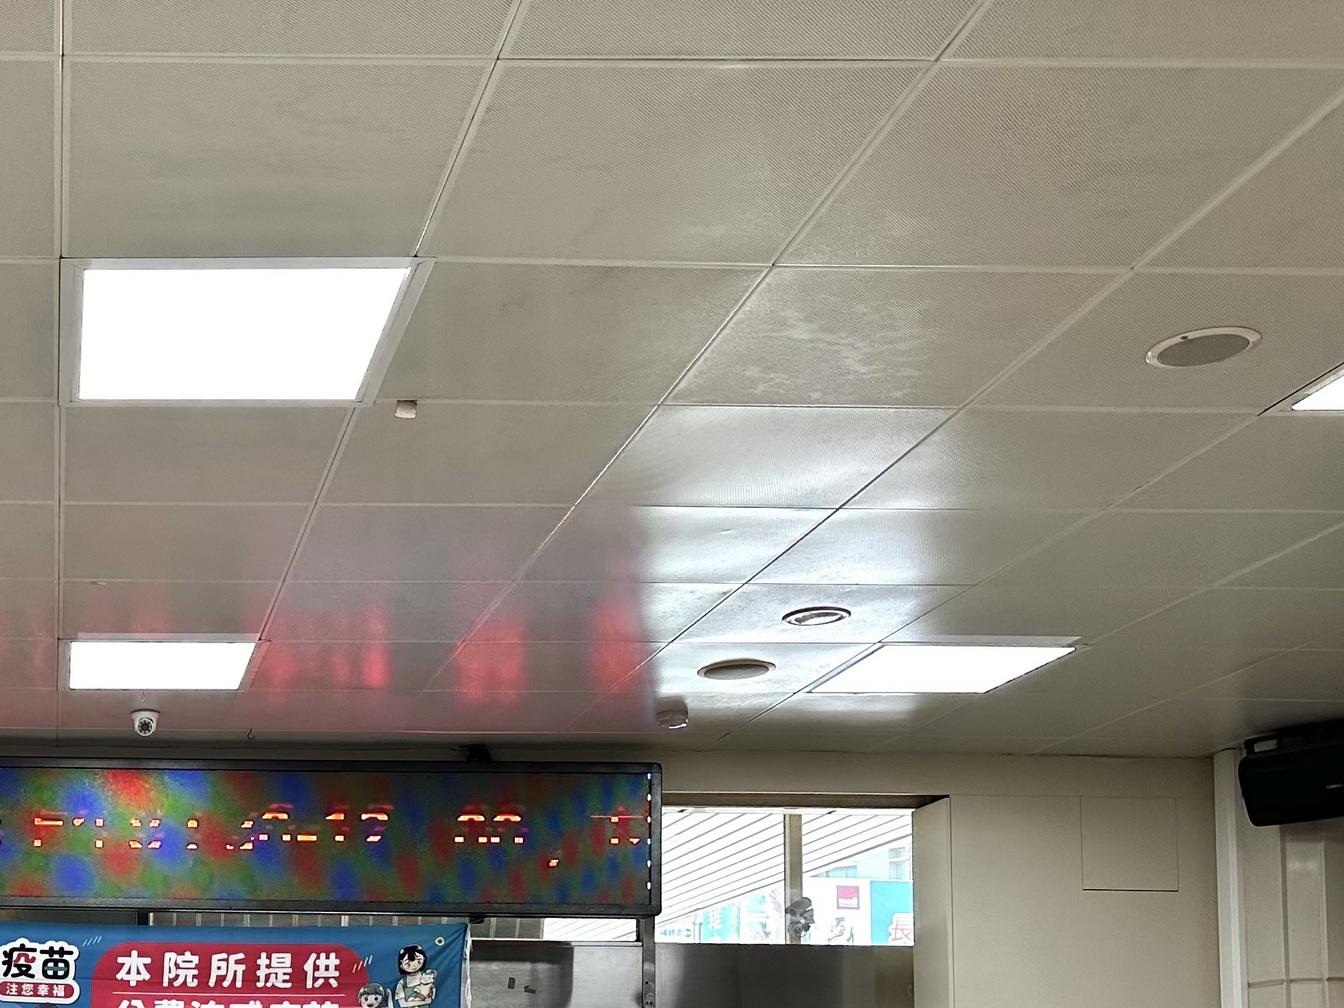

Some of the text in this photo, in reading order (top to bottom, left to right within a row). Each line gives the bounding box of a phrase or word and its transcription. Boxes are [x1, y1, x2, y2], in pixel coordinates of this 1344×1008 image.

[115, 950, 340, 988] 本院所提供
[6, 982, 67, 997] 注您幸福
